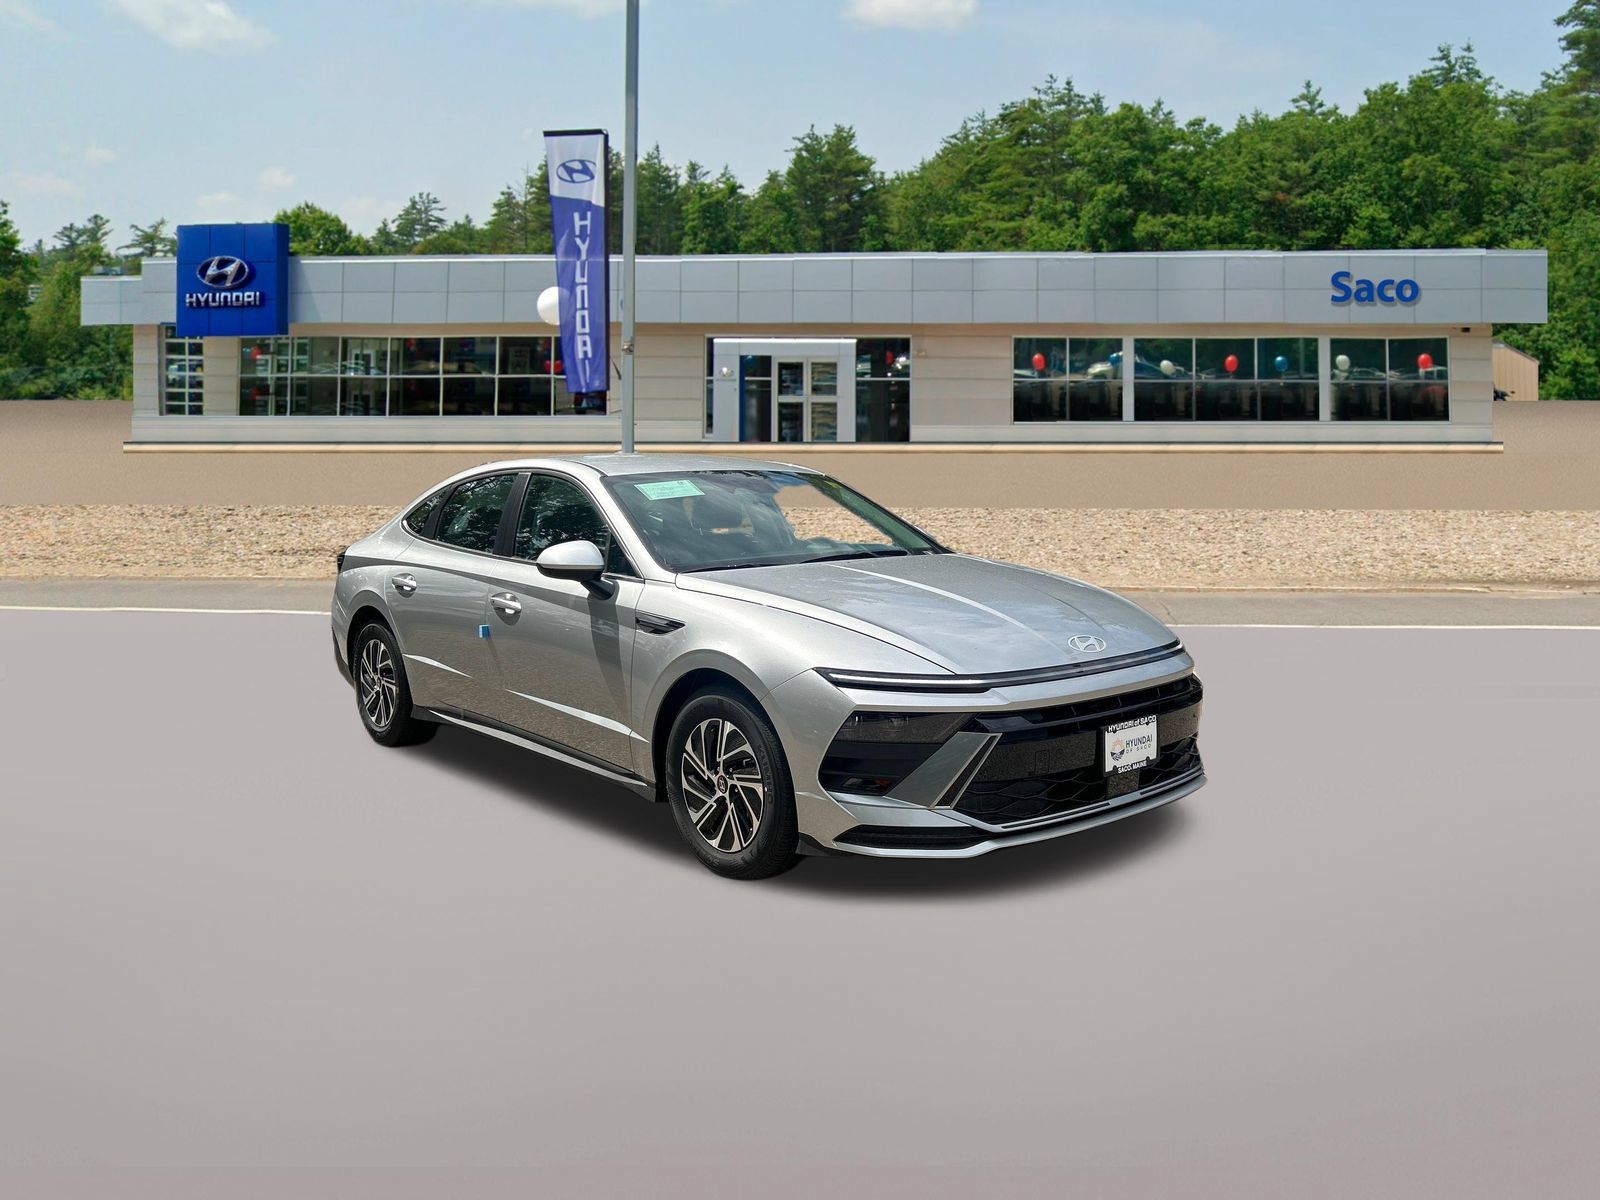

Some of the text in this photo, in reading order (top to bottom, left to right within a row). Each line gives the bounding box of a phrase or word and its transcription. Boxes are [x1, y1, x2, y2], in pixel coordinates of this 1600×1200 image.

[1330, 270, 1420, 304] Saco
[185, 291, 260, 307] HYUNDAI
[573, 210, 593, 384] HYUNDAI
[1108, 720, 1134, 732] HYUNDAI
[1140, 715, 1156, 725] SACO
[1125, 734, 1152, 748] HYUNDAI
[1136, 743, 1151, 752] SACO
[1132, 760, 1147, 769] MAINE
